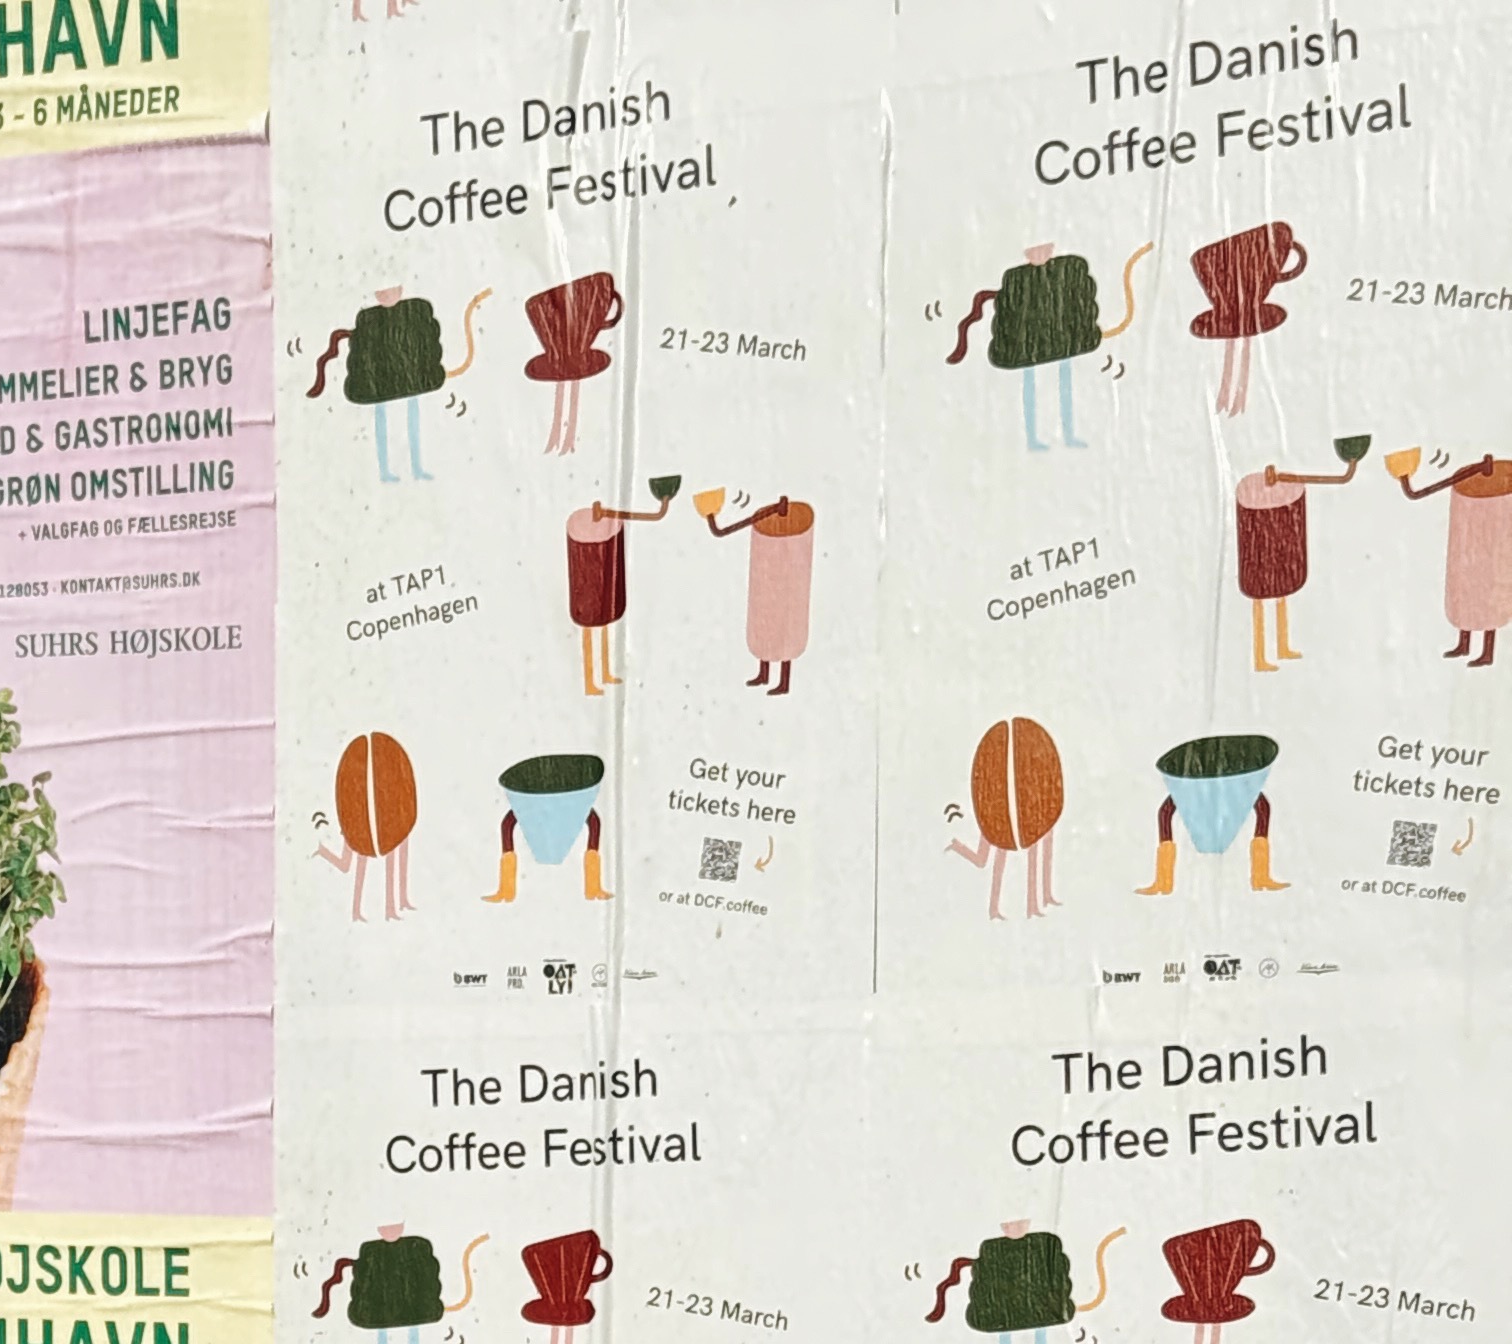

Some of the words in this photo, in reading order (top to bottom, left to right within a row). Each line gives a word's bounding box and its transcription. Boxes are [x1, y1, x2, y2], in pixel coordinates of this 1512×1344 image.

[1076, 56, 1168, 104] The
[1189, 18, 1358, 87] Danish
[420, 111, 504, 155] The
[523, 81, 670, 144] Danish
[1035, 127, 1196, 185] Coffee
[1218, 83, 1411, 157] Festival
[384, 179, 528, 231] Coffee
[547, 144, 716, 209] Festival
[1347, 278, 1425, 305] 21-23
[1434, 284, 1512, 311] March
[83, 297, 231, 344] LINJEFAG
[660, 327, 729, 354] 21-23
[737, 334, 806, 361] March
[130, 362, 147, 392] &
[159, 354, 232, 390] BRYG
[26, 424, 43, 453] &
[55, 407, 233, 451] GASTRONOMI
[71, 460, 233, 501] OMSTILLING
[31, 520, 99, 541] VALGFAG
[104, 519, 123, 536] OG
[128, 510, 236, 534] FÆLLESREJSE
[1010, 557, 1033, 580] at
[1037, 537, 1098, 571] TAP1
[366, 585, 386, 603] at
[391, 565, 447, 596] TAP1
[987, 569, 1135, 620] Copenhagen
[347, 596, 478, 641] Copenhagen
[15, 632, 98, 658] SUHRS
[110, 625, 242, 659] HØJSKOLE
[690, 758, 729, 782] Get
[736, 769, 786, 790] your
[1378, 736, 1423, 761] Get
[1431, 746, 1489, 769] your
[669, 790, 740, 817] tickets
[747, 799, 796, 824] here
[1354, 770, 1435, 798] tickets
[1443, 778, 1500, 804] here
[659, 892, 673, 902] or
[676, 892, 690, 905] at
[694, 893, 767, 916] DCF.coffee
[421, 1068, 501, 1107] The
[520, 1059, 657, 1103] Danish
[1052, 1052, 1142, 1094] The
[1163, 1035, 1326, 1086] Danish
[386, 1132, 526, 1173] Coffee
[544, 1122, 701, 1167] Festival
[1012, 1119, 1168, 1166] Coffee
[1189, 1101, 1377, 1154] Festival
[647, 1287, 713, 1316] 21-23
[720, 1300, 787, 1331] March
[1314, 1279, 1389, 1308] 21-23
[1398, 1291, 1475, 1321] March
